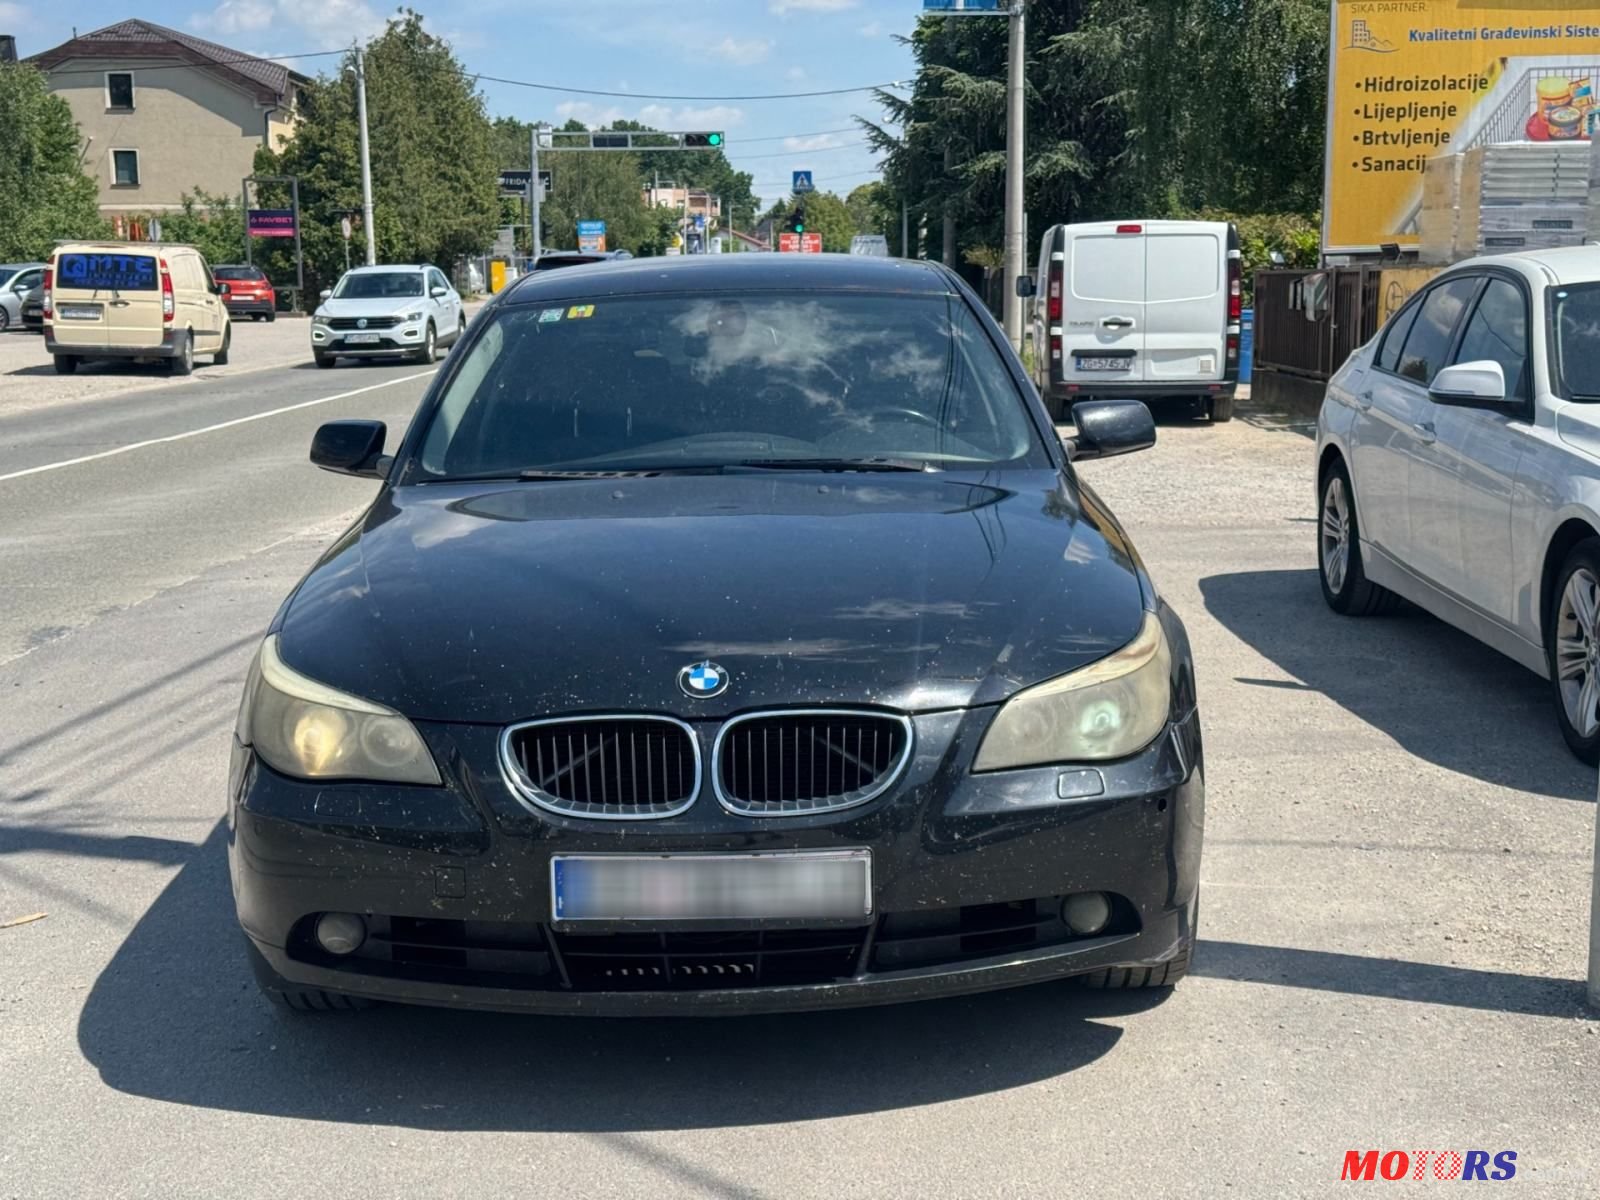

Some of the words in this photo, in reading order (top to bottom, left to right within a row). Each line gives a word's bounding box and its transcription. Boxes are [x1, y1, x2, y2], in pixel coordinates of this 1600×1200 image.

[1351, 3, 1375, 14] SIKA
[1409, 27, 1477, 41] Kvalitetni
[1565, 25, 1600, 37] Siste
[1364, 74, 1489, 93] Hidroizolacije
[1363, 101, 1457, 122] Lijepljenje
[1362, 128, 1451, 148] Brtvljenje
[1361, 154, 1428, 174] Sanacij
